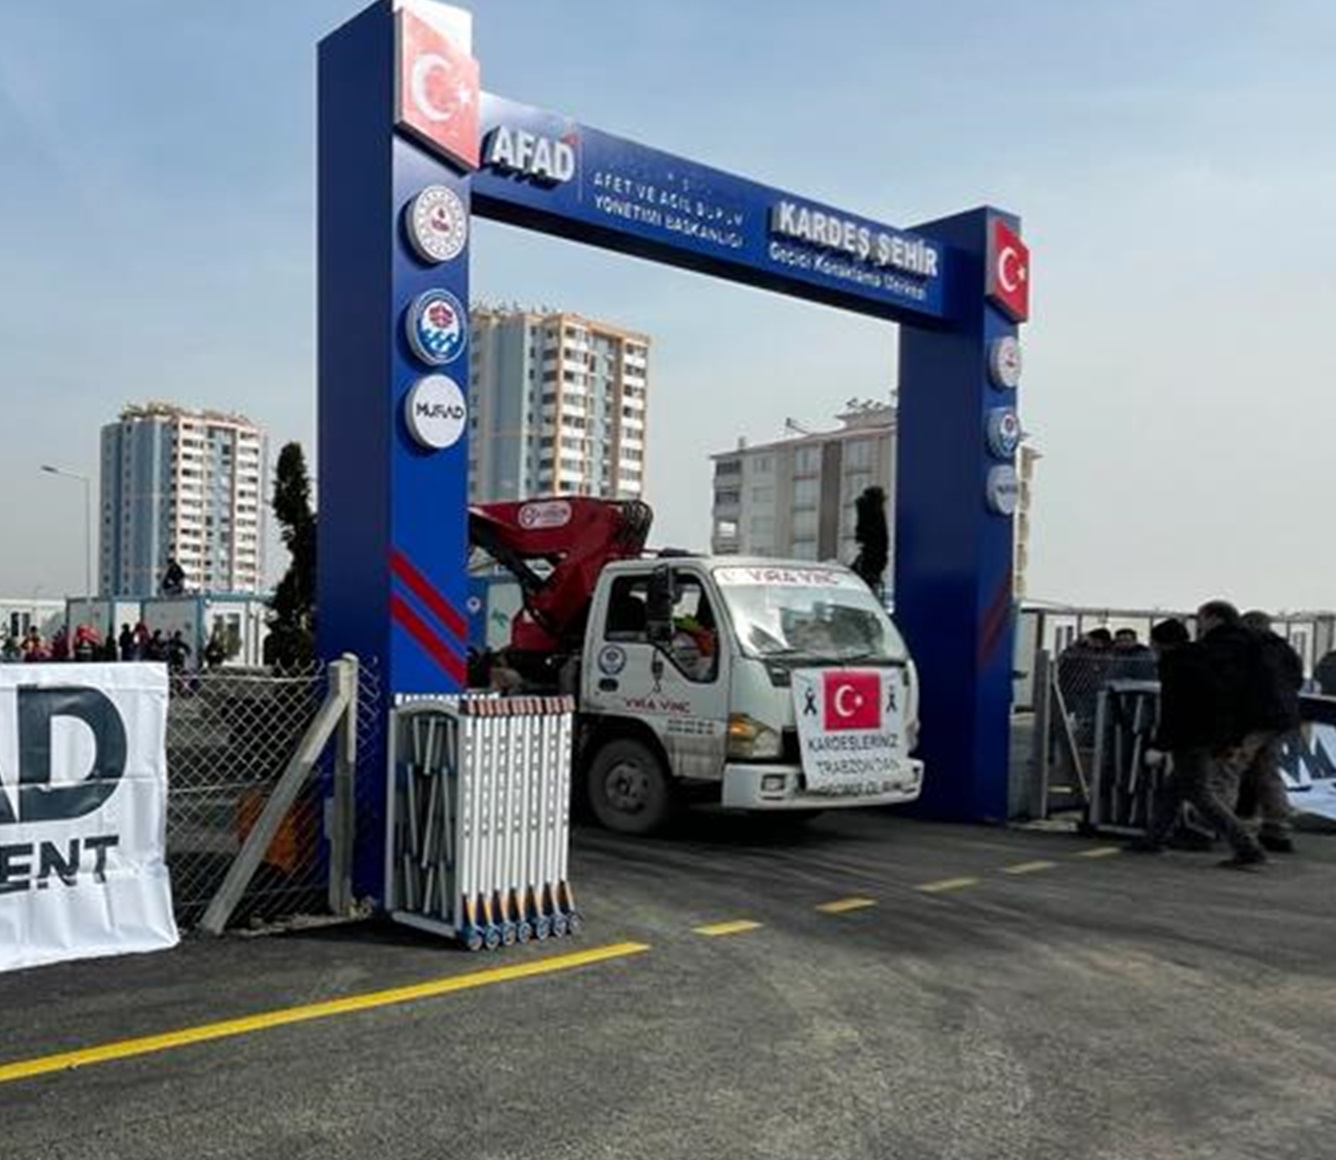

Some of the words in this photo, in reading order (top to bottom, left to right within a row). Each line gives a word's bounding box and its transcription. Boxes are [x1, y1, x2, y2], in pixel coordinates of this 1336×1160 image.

[491, 125, 575, 182] AFAD
[779, 201, 870, 257] KARDEŞ
[877, 233, 938, 277] ŞEHİR
